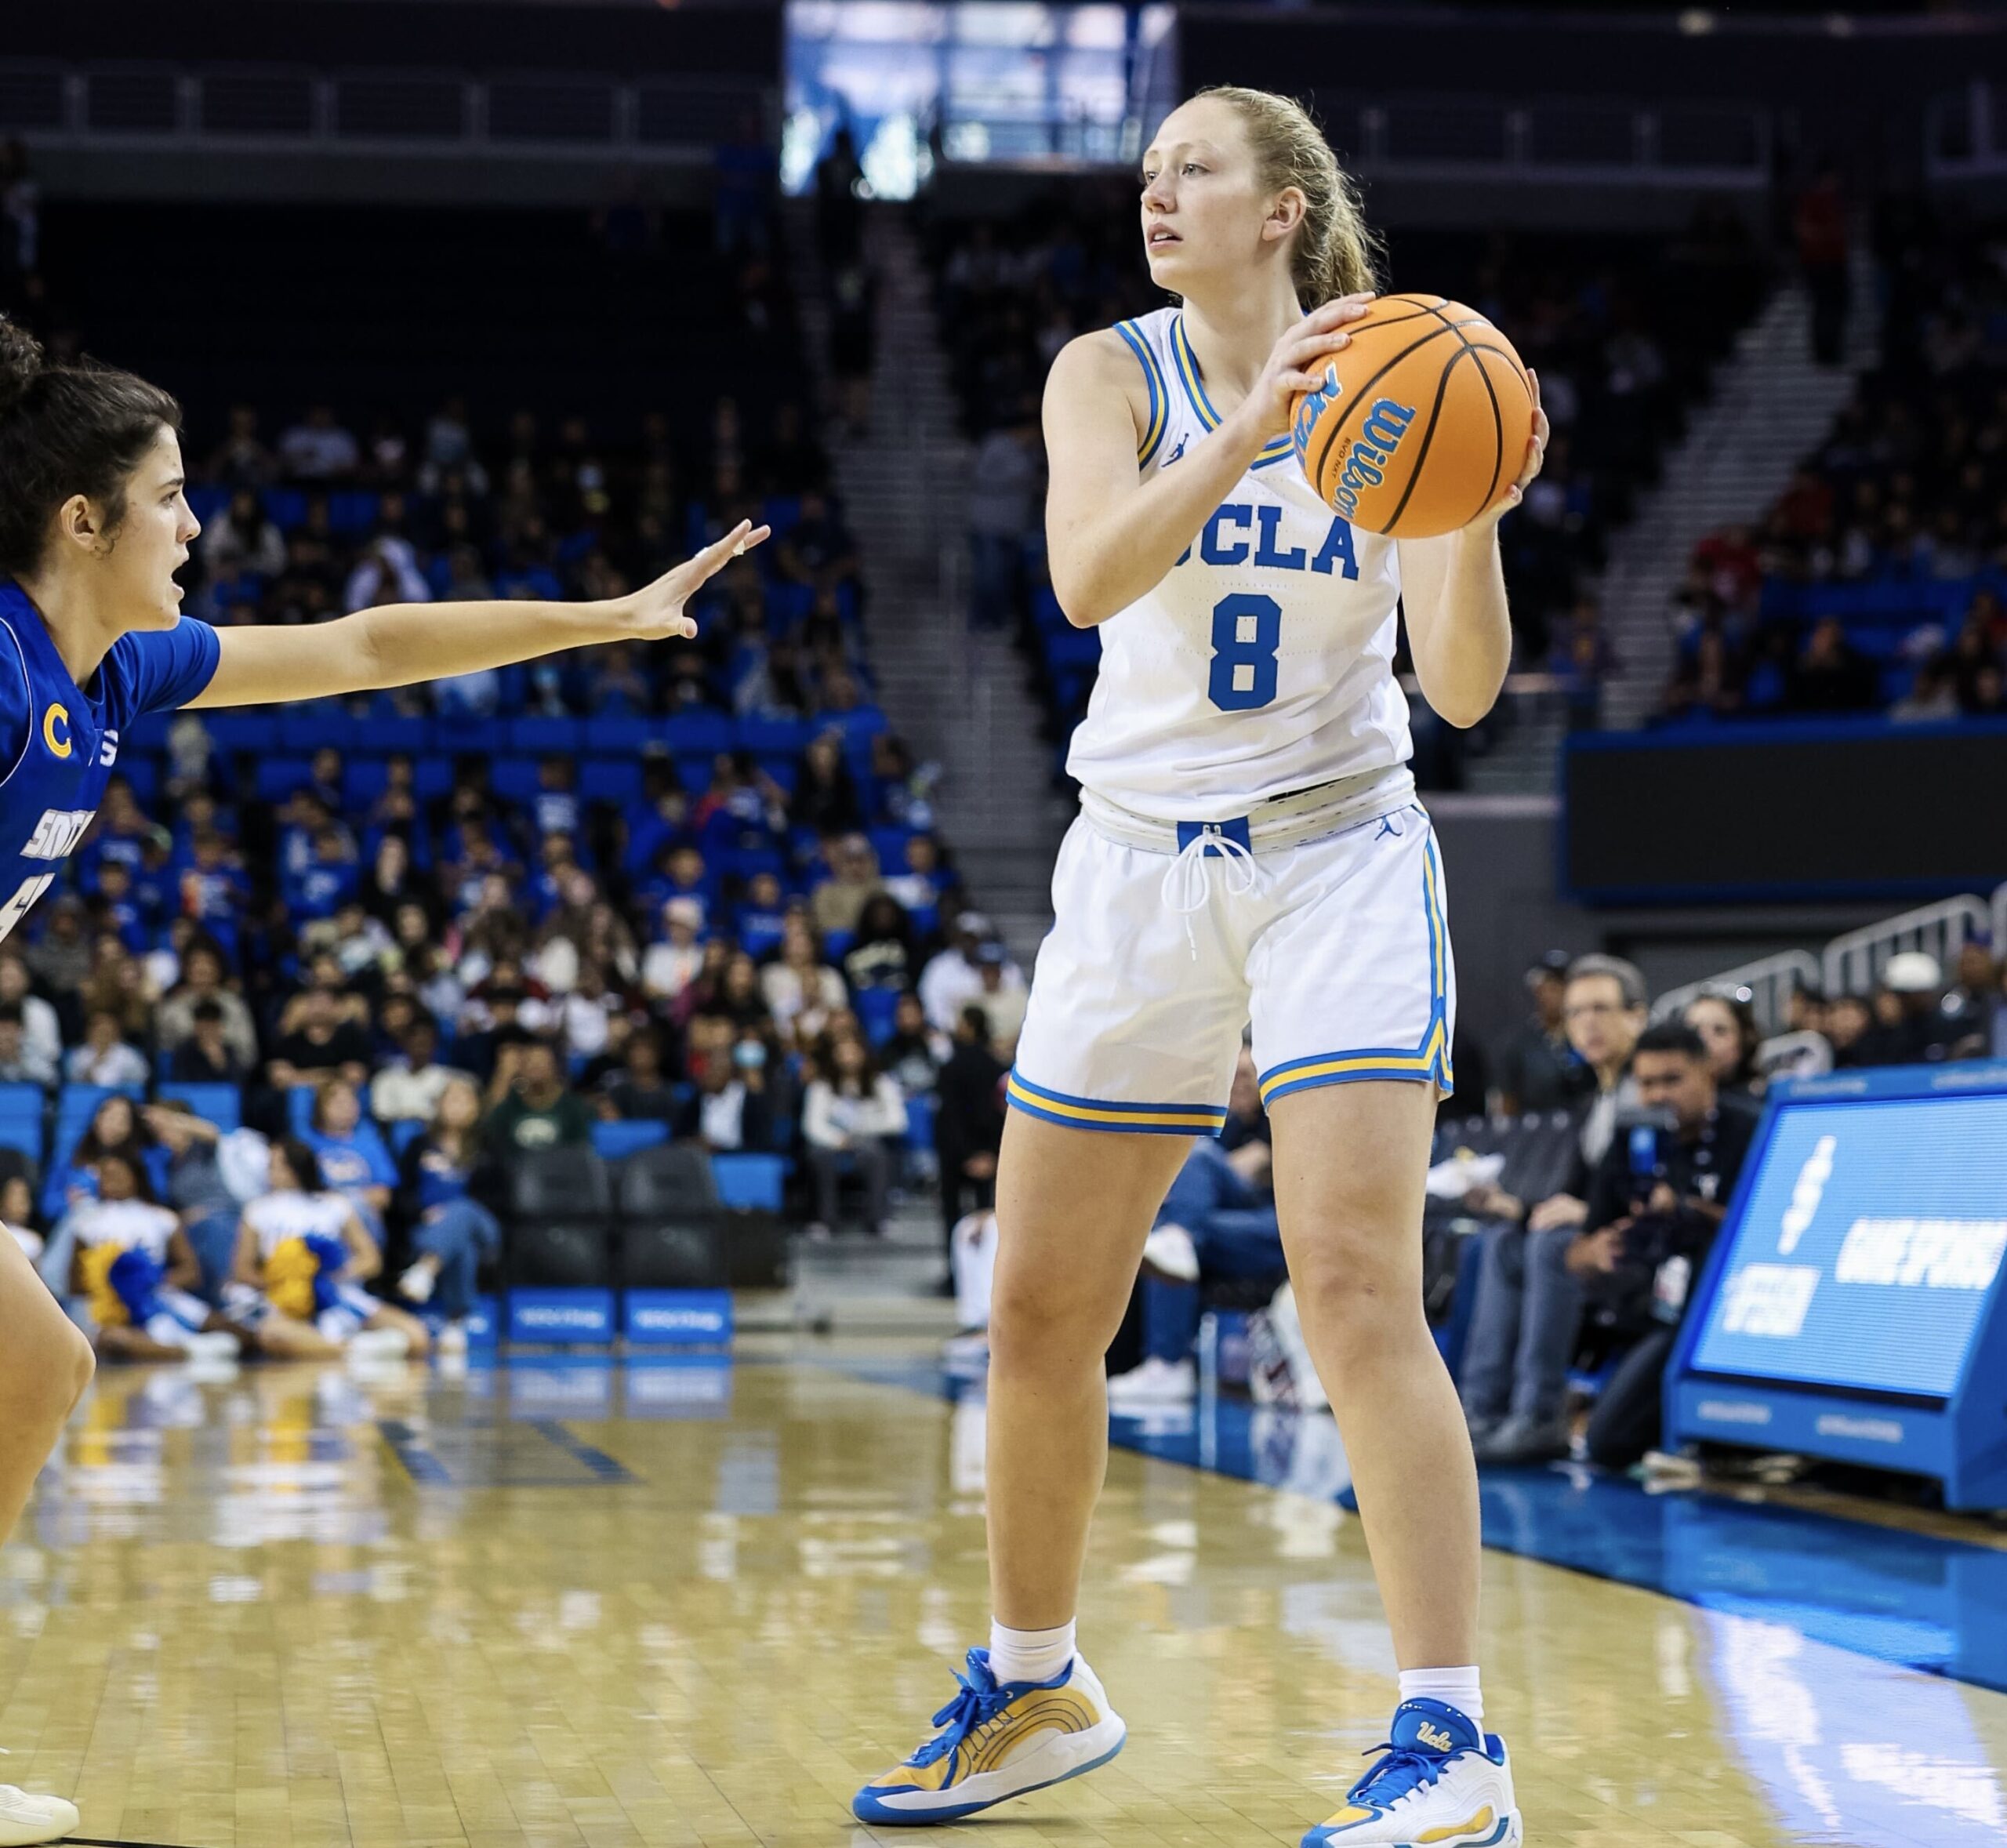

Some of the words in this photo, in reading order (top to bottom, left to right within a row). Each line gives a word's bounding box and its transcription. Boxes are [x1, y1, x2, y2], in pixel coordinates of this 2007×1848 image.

[1334, 398, 1417, 520] Wilson
[1174, 503, 1359, 581] CLA
[1208, 593, 1283, 711] 8
[43, 703, 73, 759] C
